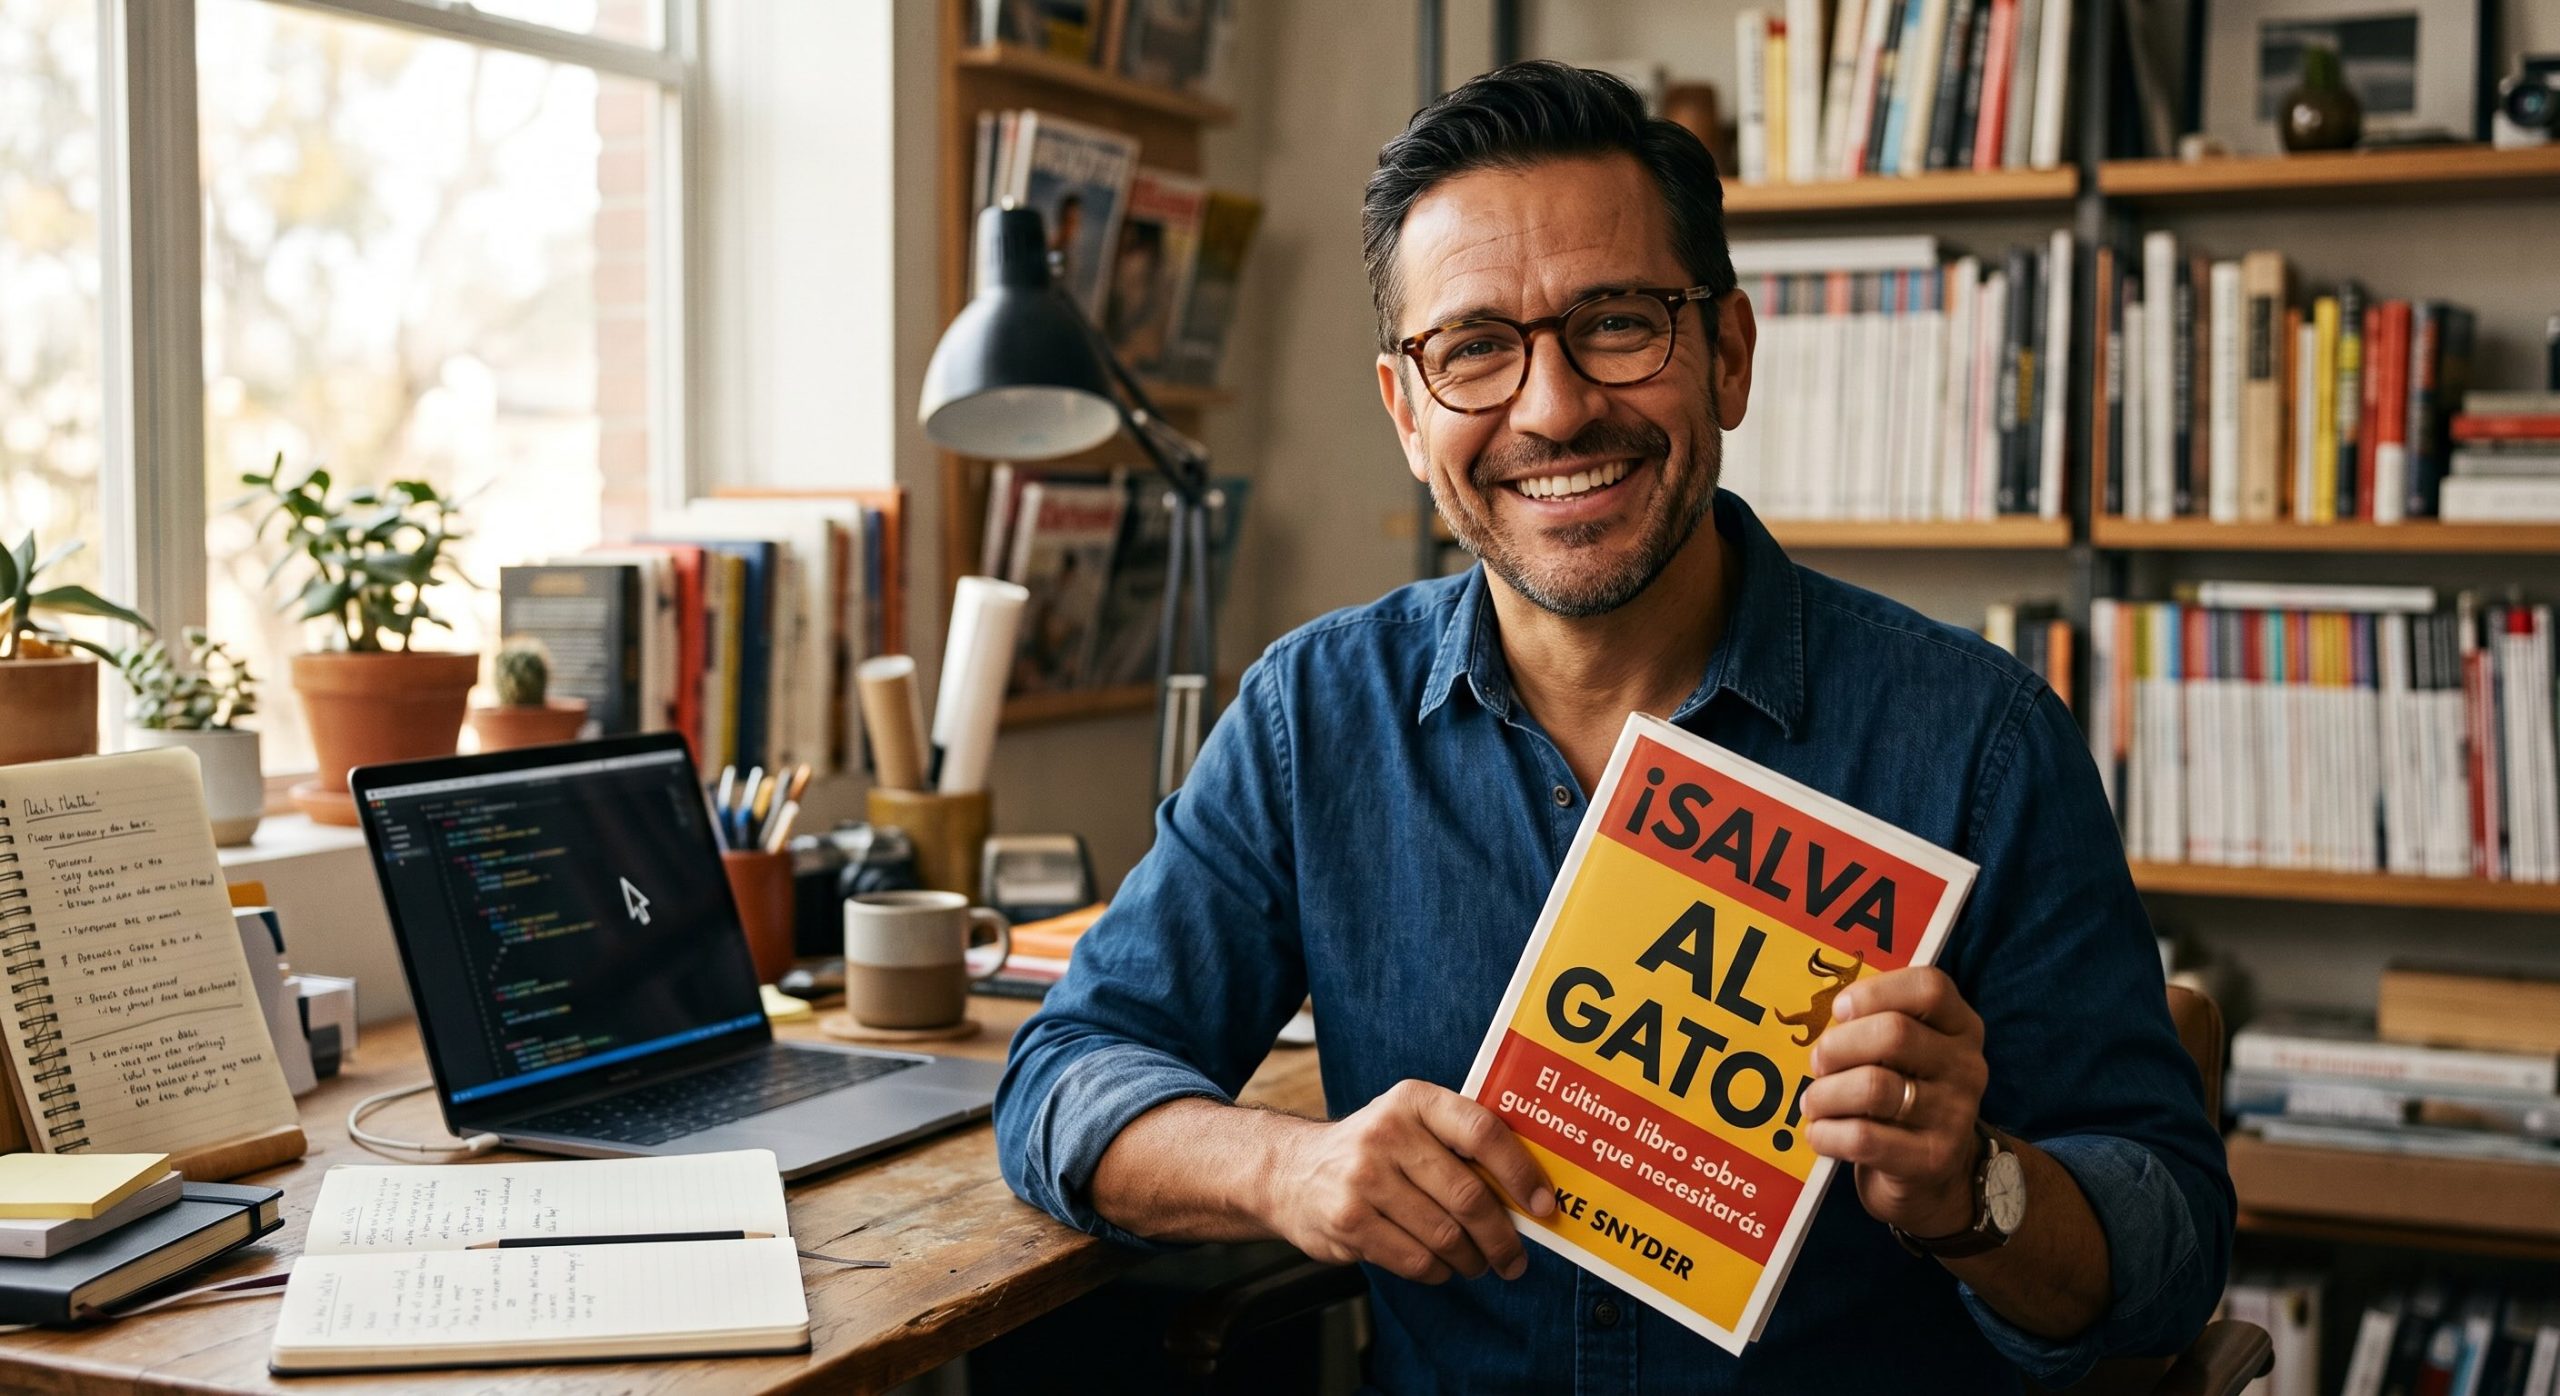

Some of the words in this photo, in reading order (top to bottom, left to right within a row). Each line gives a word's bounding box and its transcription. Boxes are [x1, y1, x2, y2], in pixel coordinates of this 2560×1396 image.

[1625, 766, 1896, 954] ¡SALVA
[1635, 900, 1768, 1026] AL
[1546, 966, 1815, 1152] GATO!
[1498, 1090, 1588, 1145] guiones
[1591, 1138, 1634, 1169] que
[1637, 1159, 1766, 1239] necesitarás
[1535, 1066, 1560, 1094] El
[1560, 1082, 1631, 1132] último
[1634, 1117, 1688, 1162] libro
[1691, 1155, 1758, 1199] sobre
[1555, 1187, 1588, 1220] KE
[1590, 1209, 1694, 1281] SNYDER
